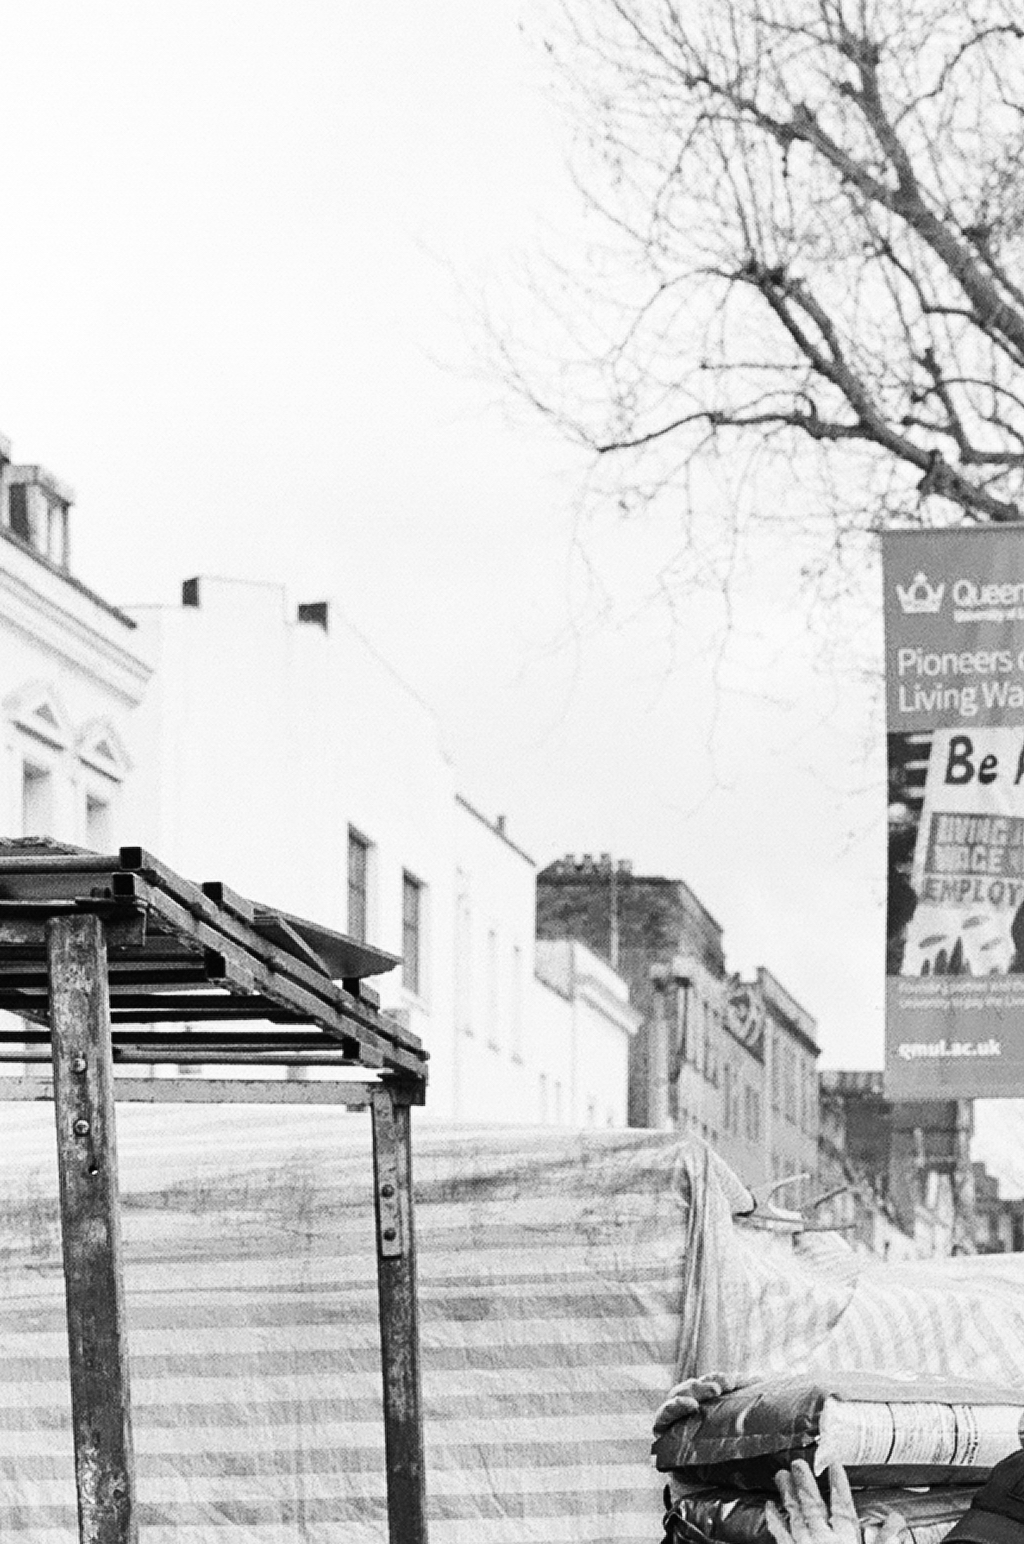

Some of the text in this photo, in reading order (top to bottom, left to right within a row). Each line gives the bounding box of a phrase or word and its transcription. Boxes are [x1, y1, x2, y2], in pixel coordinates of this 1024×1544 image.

[898, 647, 1013, 676] Pioneers
[899, 682, 978, 716] Living
[944, 735, 998, 785] Be
[899, 1039, 1001, 1061] qmul.ac.uk
